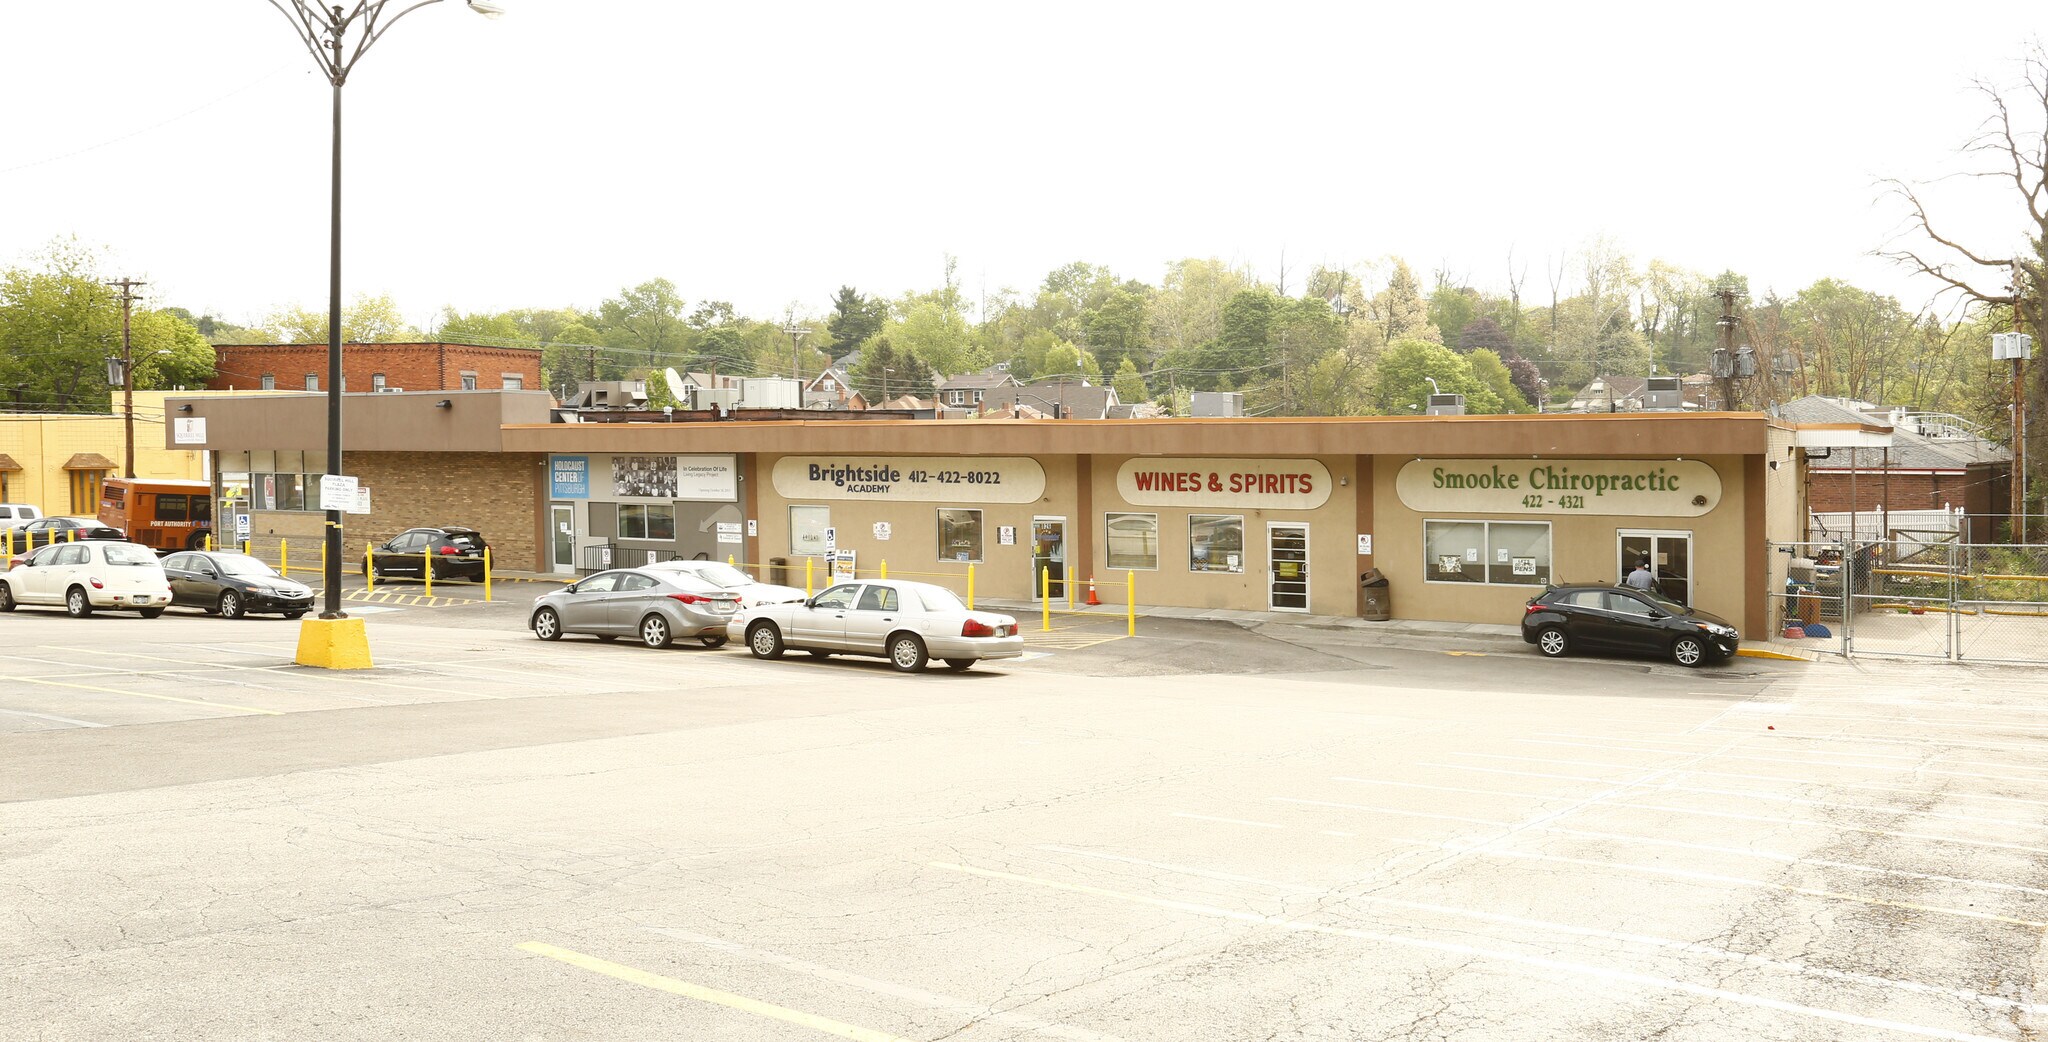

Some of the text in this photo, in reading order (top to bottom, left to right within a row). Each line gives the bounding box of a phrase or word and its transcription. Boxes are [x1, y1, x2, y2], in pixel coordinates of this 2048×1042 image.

[554, 460, 585, 471] HOLOCAUST
[554, 471, 577, 482] CENTER
[808, 463, 1001, 486] Brightside 412-422-8022
[1432, 465, 1680, 496] Smooke Chiropractic
[554, 482, 586, 494] PITTSBURGH
[846, 484, 890, 493] ACADEMY
[1134, 472, 1313, 494] WINES & SPIRITS
[1522, 495, 1543, 508] 422
[1558, 495, 1584, 509] 4321
[164, 520, 191, 528] AUTHORITY
